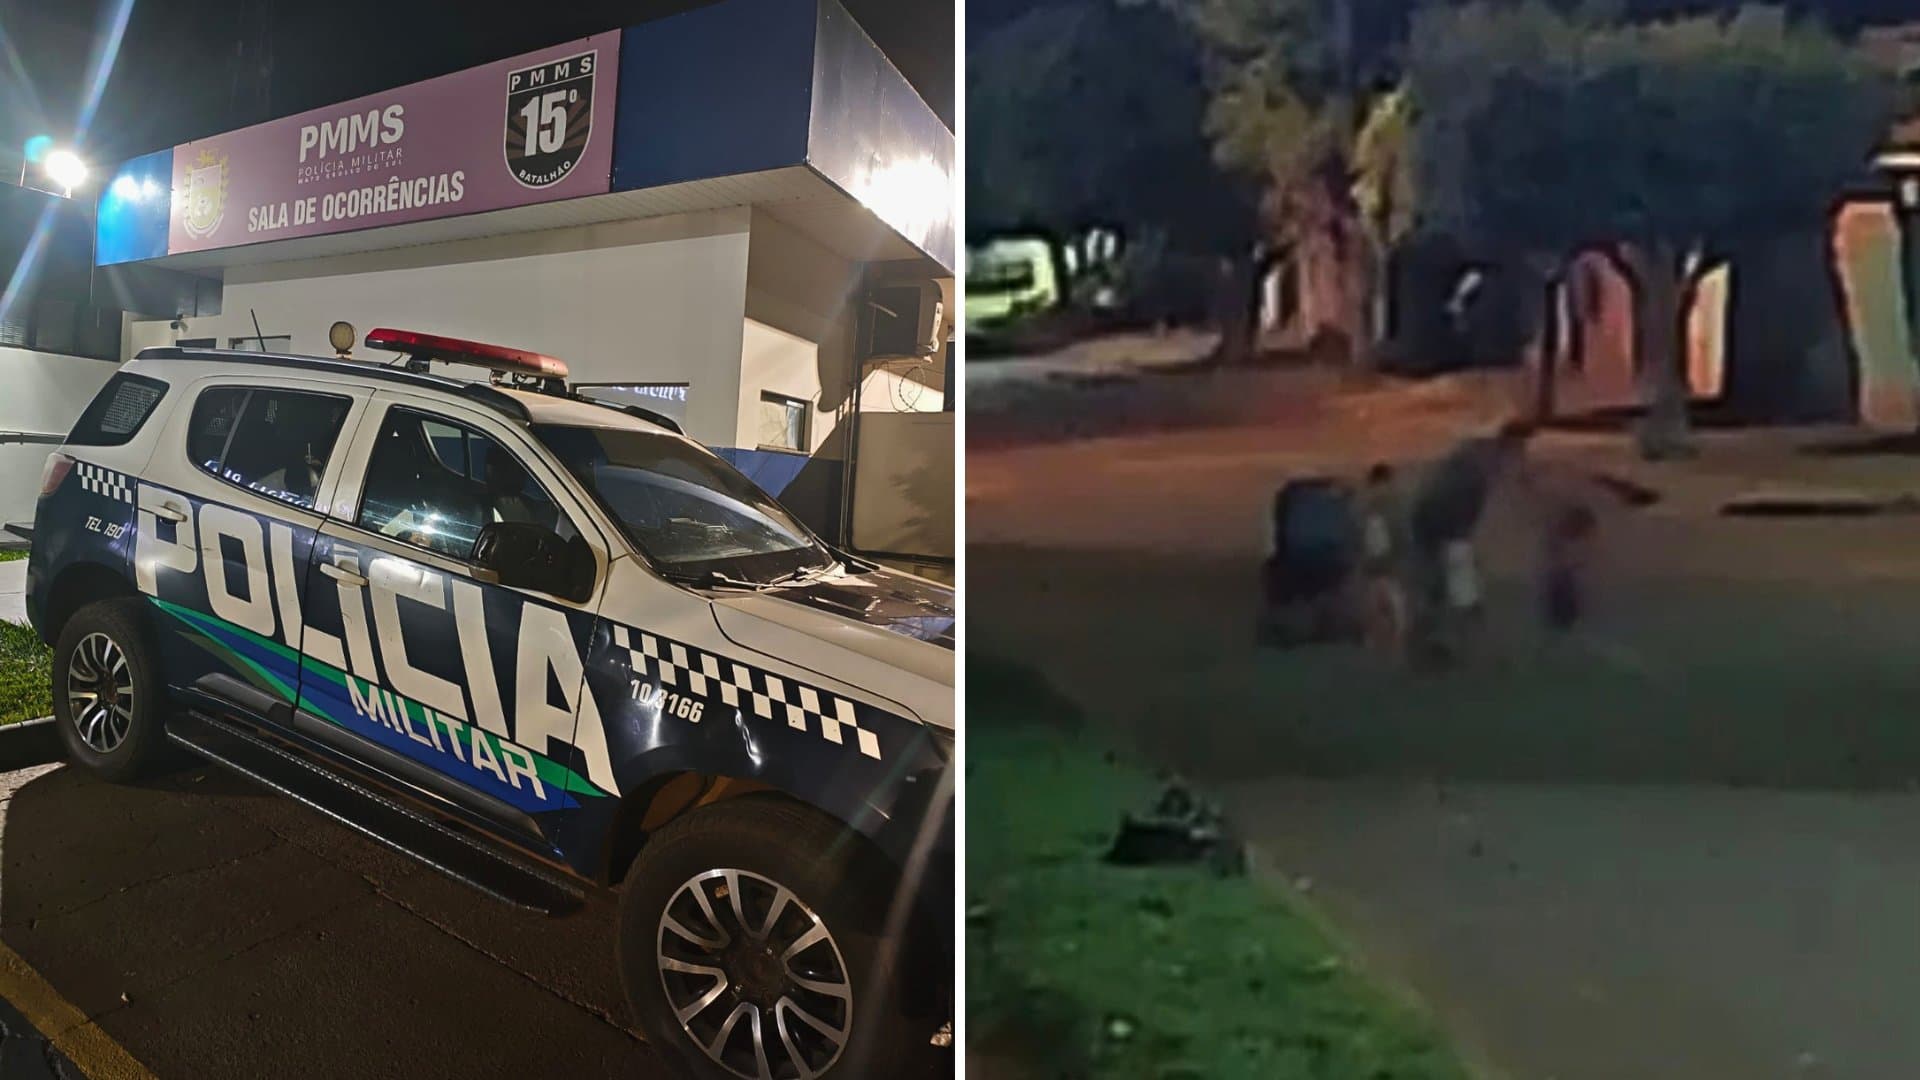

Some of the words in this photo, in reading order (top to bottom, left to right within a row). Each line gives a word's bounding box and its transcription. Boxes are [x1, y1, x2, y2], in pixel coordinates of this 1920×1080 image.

[511, 57, 592, 91] PMMS
[299, 104, 404, 163] PMMS
[298, 159, 344, 177] POLÍCIA
[351, 147, 402, 168] MILITAR
[519, 160, 571, 184] BATALHÃO
[248, 202, 289, 232] SALA
[294, 197, 317, 225] DE
[322, 170, 464, 222] OCORRÊNCIAS
[86, 516, 102, 532] TEL
[103, 522, 126, 540] 190
[345, 674, 547, 800] MILITAR
